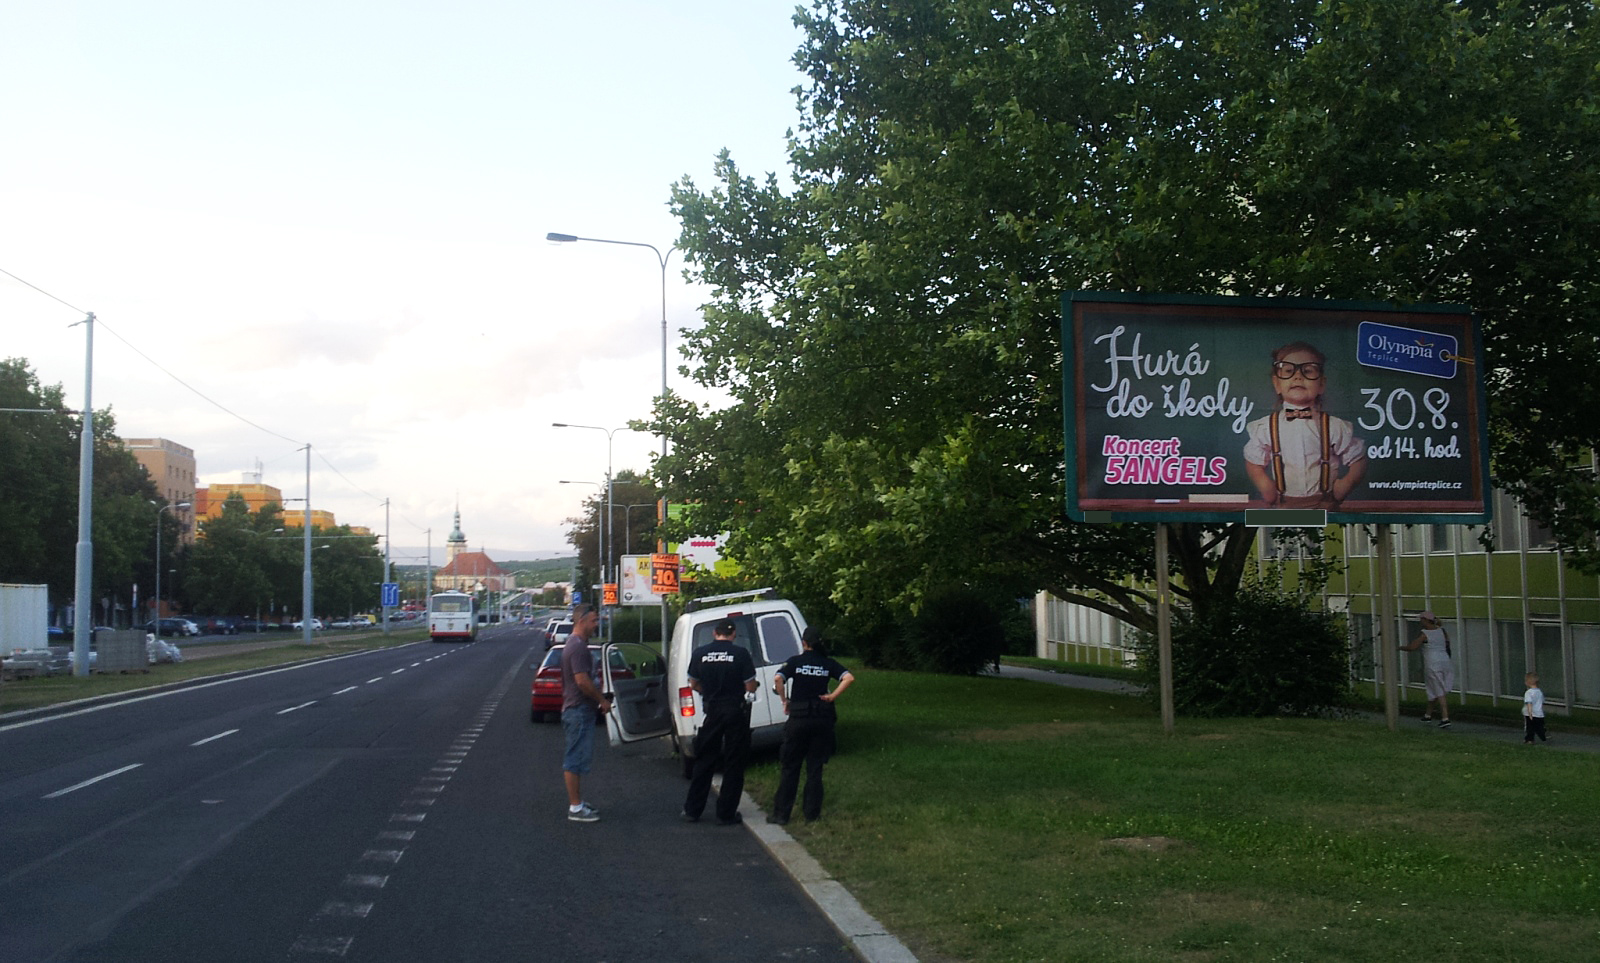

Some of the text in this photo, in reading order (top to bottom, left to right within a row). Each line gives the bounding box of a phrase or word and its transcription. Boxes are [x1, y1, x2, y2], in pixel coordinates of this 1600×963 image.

[1367, 350, 1399, 363] Teplice
[1368, 334, 1433, 359] Olympia
[1091, 325, 1210, 392] Hurá
[1106, 378, 1254, 434] do školy
[1357, 387, 1459, 431] 30.8.
[1102, 435, 1181, 456] Koncert
[1367, 435, 1462, 459] od 14. hod.
[1104, 456, 1227, 485] 5ANGELS
[1368, 480, 1462, 491] www.olympiateplice.cz
[638, 561, 650, 570] AK
[701, 655, 734, 663] POLICIE
[795, 667, 829, 677] POLICIE
